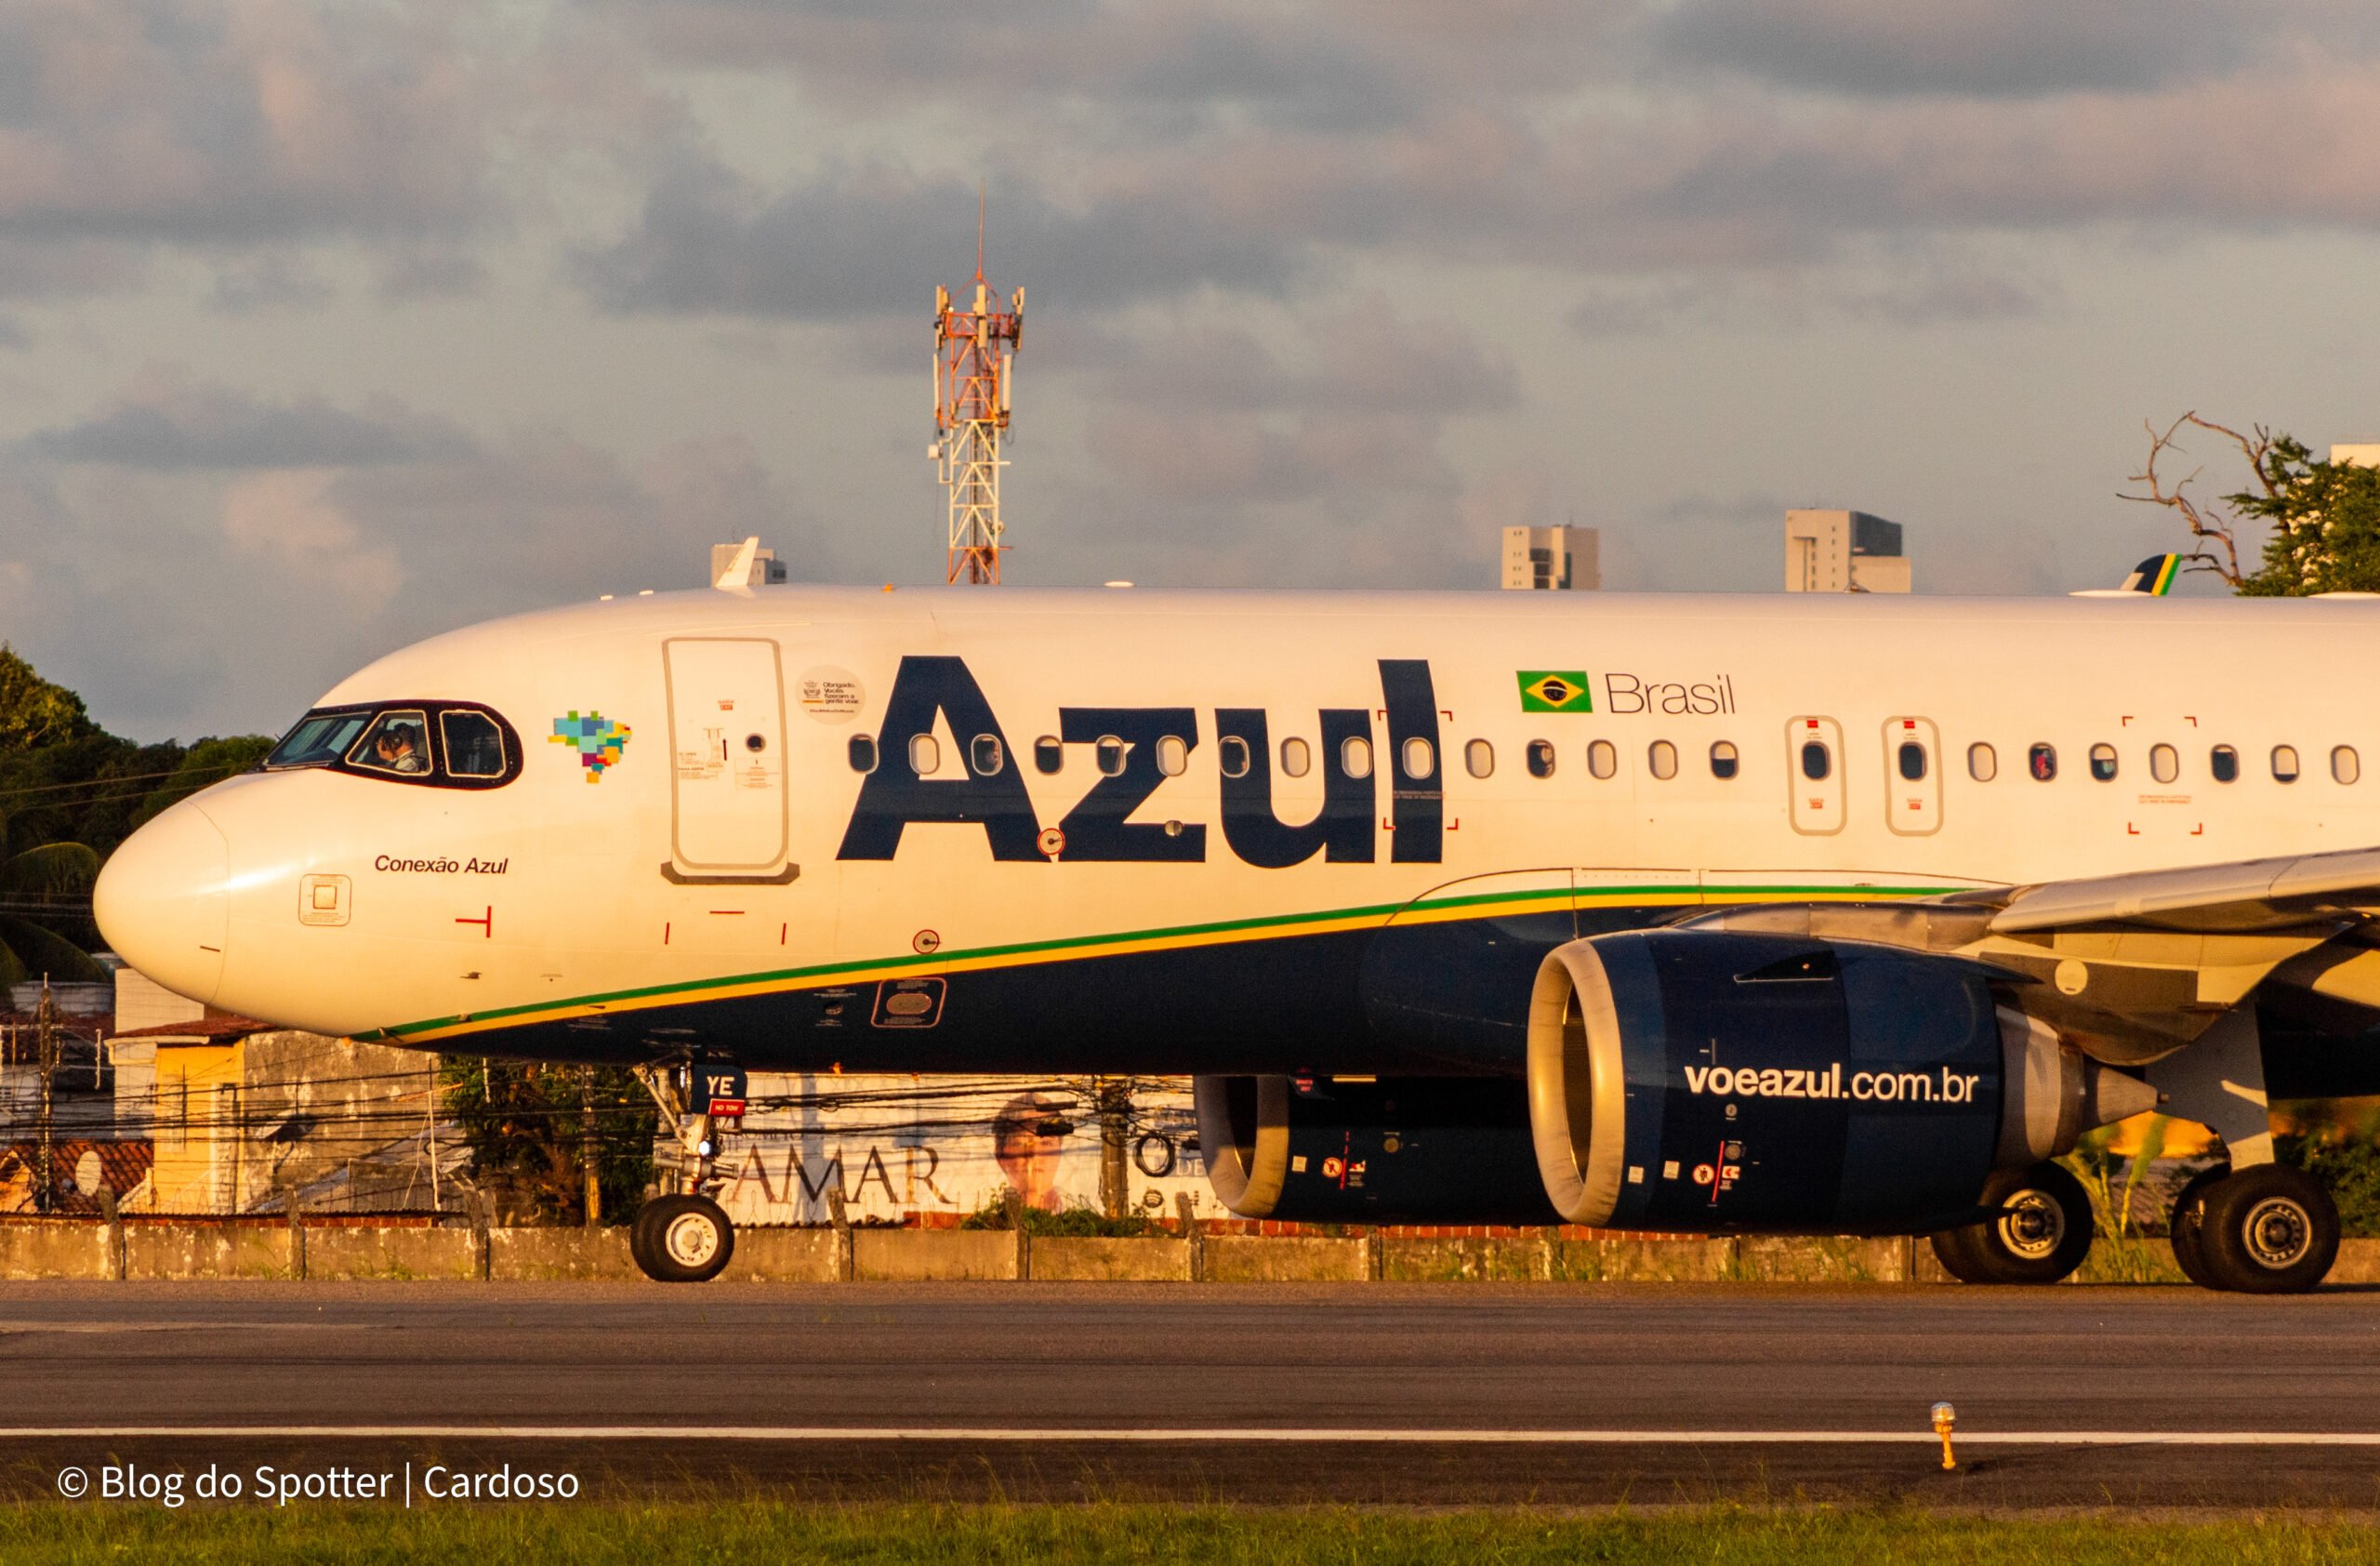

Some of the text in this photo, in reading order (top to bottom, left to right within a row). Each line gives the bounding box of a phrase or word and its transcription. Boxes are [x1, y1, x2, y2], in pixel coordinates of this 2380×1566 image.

[1606, 673, 1736, 714] Brasil
[836, 656, 1443, 869] Azul
[375, 855, 509, 874] Conexão Azul
[707, 1075, 734, 1095] YE
[1684, 1063, 1979, 1102] voeazul.com.br
